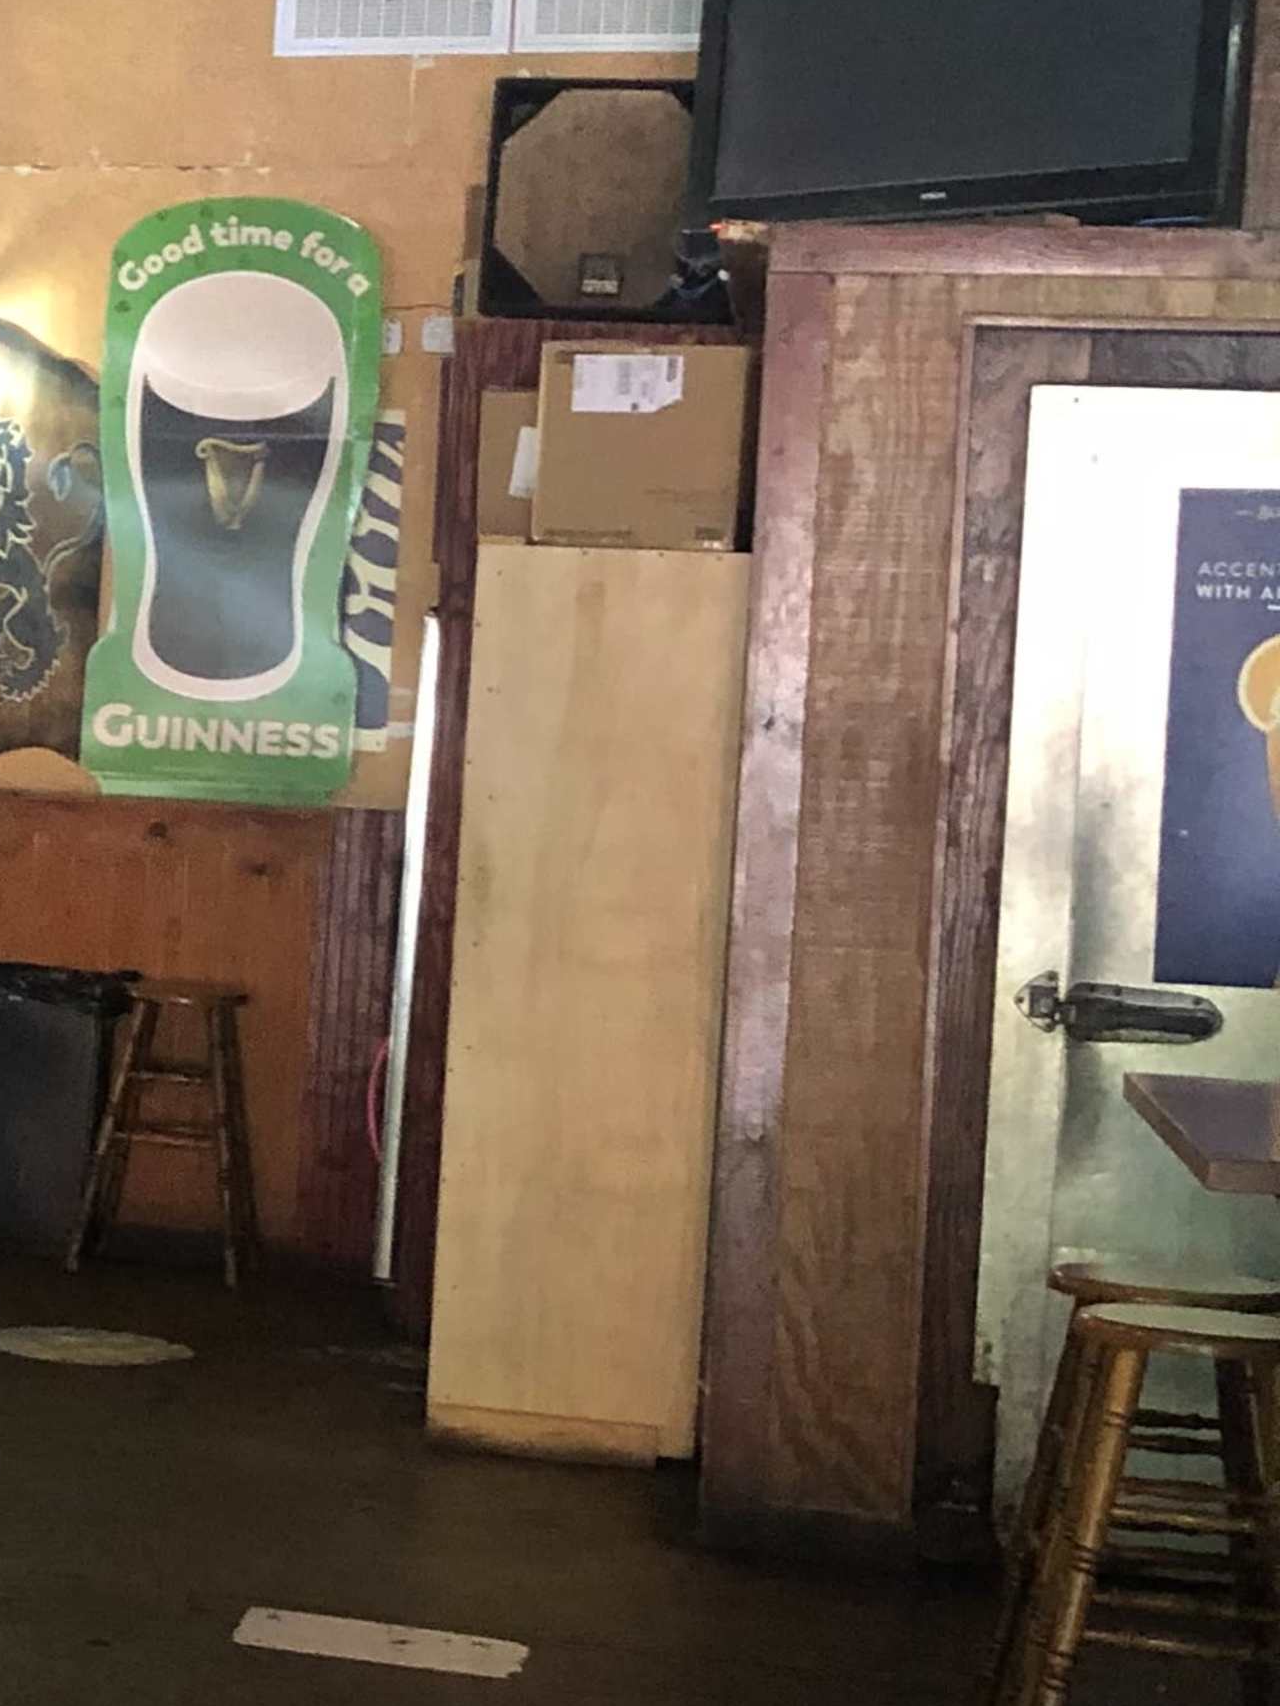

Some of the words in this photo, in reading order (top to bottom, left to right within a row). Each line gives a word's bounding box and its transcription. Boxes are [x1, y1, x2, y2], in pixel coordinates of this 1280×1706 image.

[118, 223, 205, 291] Good
[210, 215, 294, 251] time
[300, 230, 352, 274] for
[347, 273, 371, 297] a
[1198, 561, 1280, 578] ACCEN
[1196, 583, 1251, 599] WITH
[92, 702, 340, 759] GUINNESS
